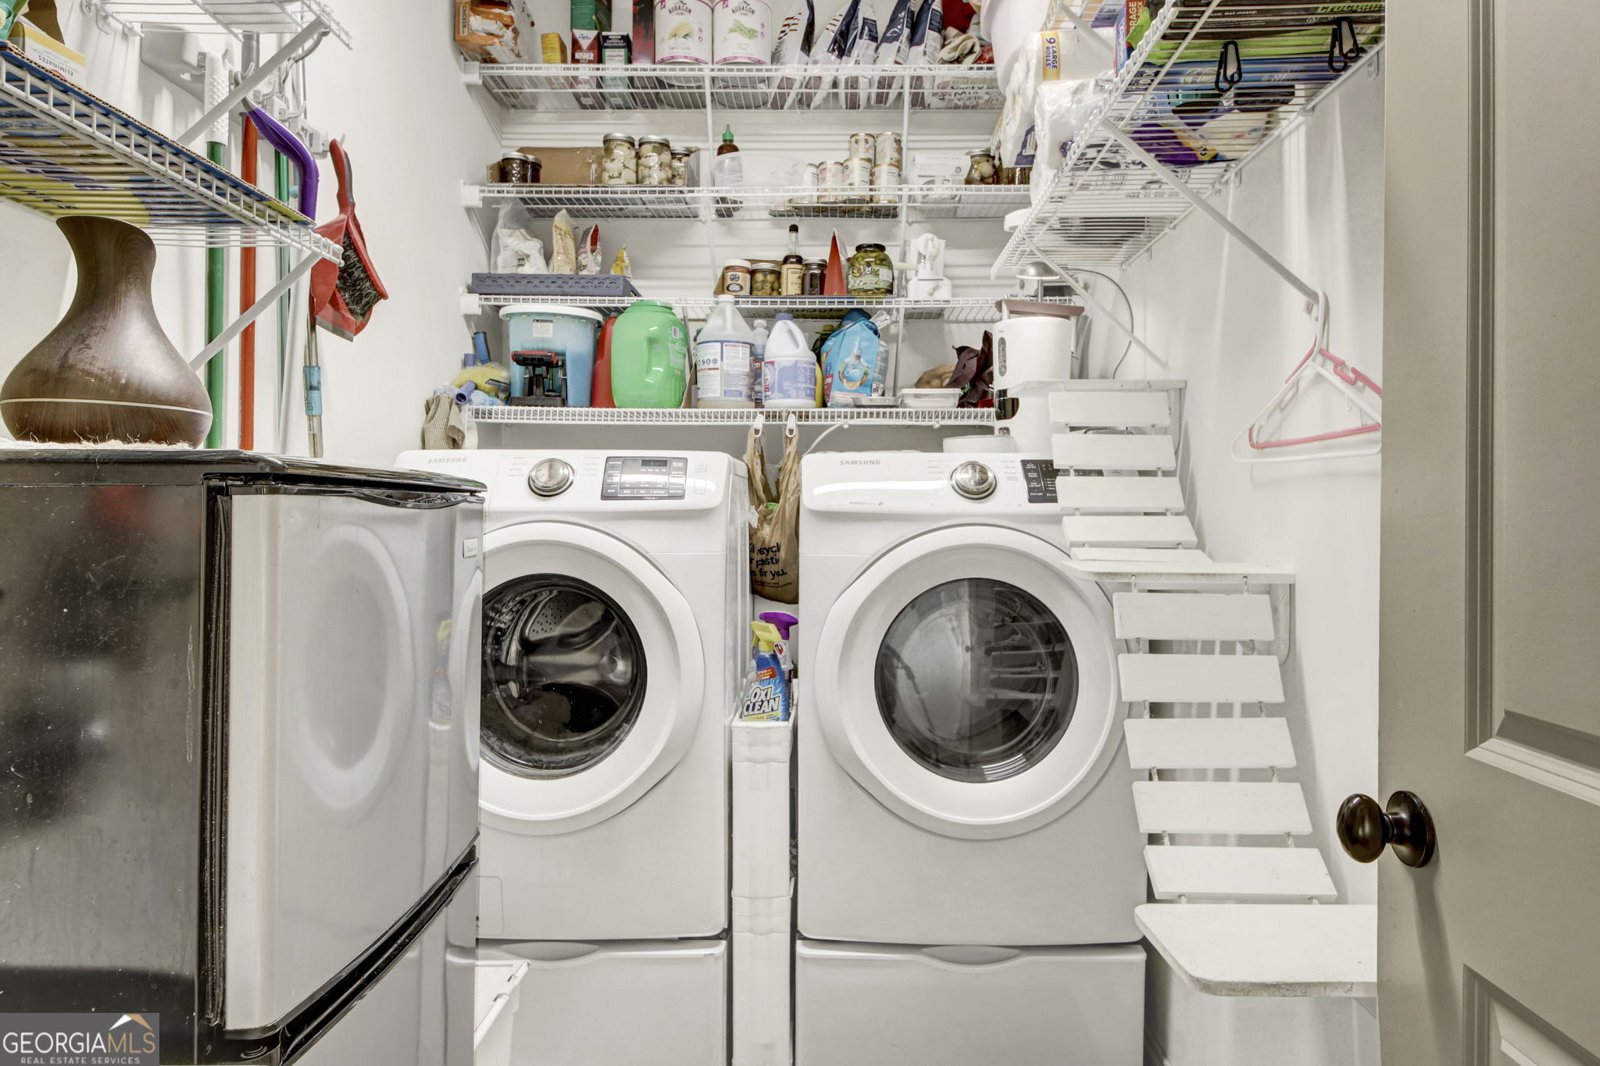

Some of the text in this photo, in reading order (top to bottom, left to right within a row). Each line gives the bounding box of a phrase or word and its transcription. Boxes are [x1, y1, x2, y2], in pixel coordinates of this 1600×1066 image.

[428, 456, 468, 464] SAMSUNG
[750, 686, 772, 703] OXI
[743, 696, 780, 716] CLEAN
